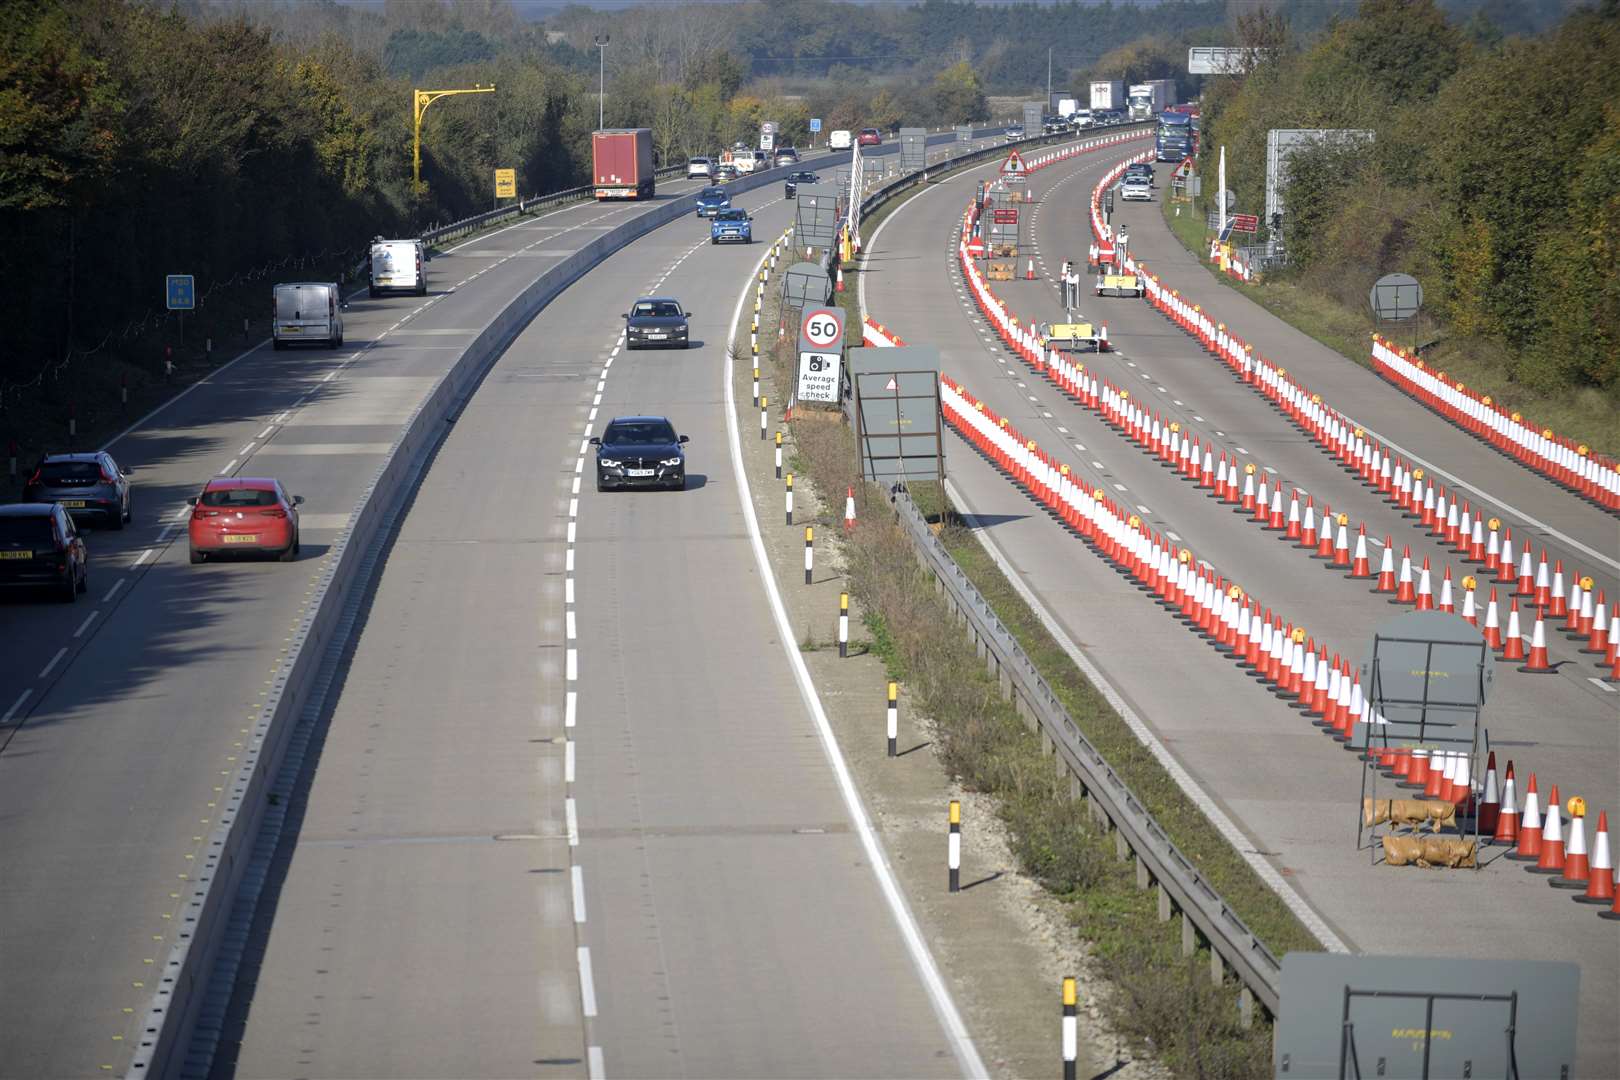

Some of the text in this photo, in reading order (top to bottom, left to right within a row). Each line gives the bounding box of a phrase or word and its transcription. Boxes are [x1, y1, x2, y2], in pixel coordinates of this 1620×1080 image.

[811, 322, 836, 337] 50
[803, 374, 836, 383] Average
[805, 391, 830, 399] check
